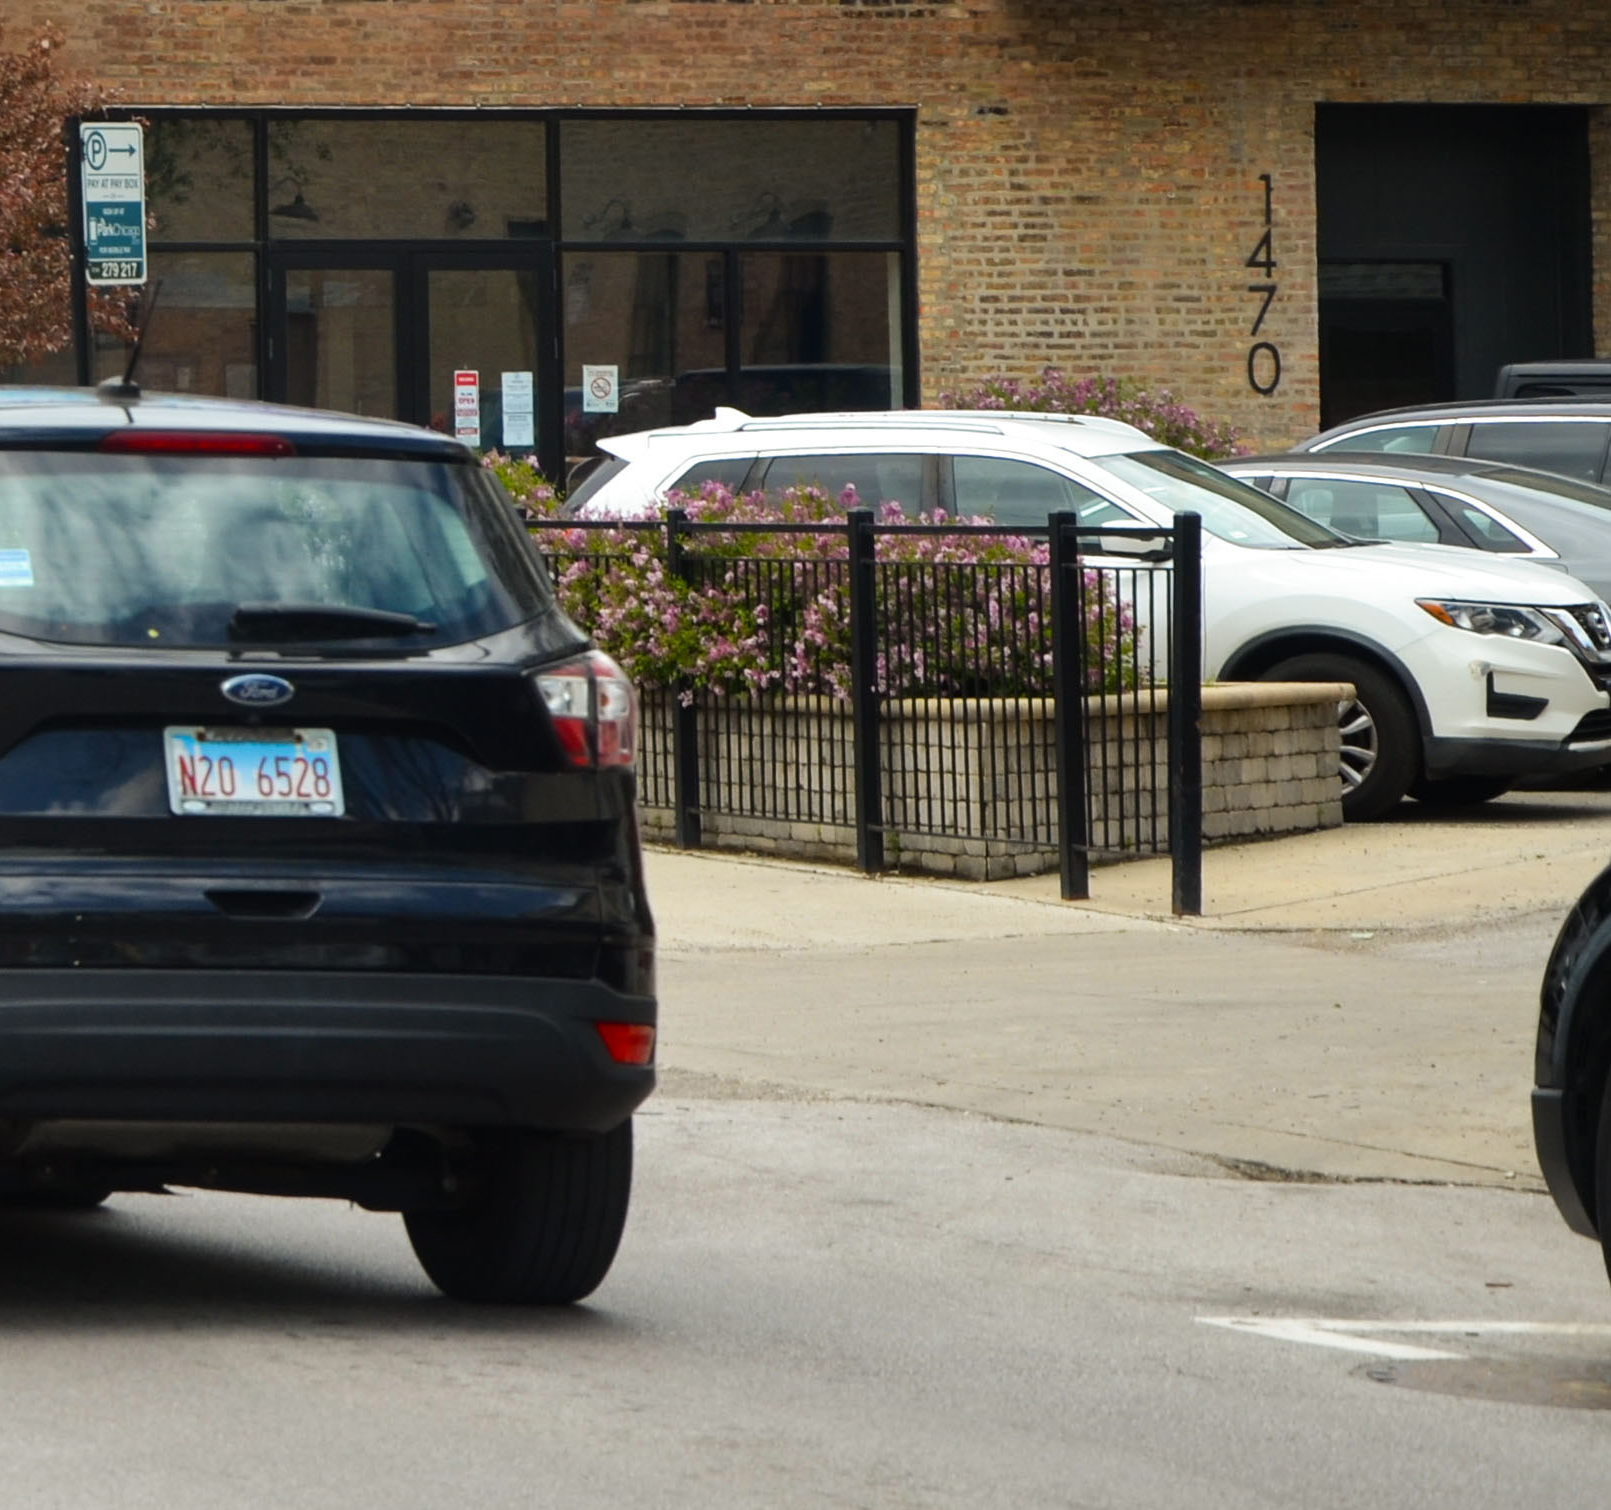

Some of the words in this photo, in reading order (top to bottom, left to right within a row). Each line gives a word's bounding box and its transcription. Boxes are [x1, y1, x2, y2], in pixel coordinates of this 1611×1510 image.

[1245, 174, 1281, 395] 1470
[239, 680, 278, 699] Ford
[257, 756, 331, 798] 6528
